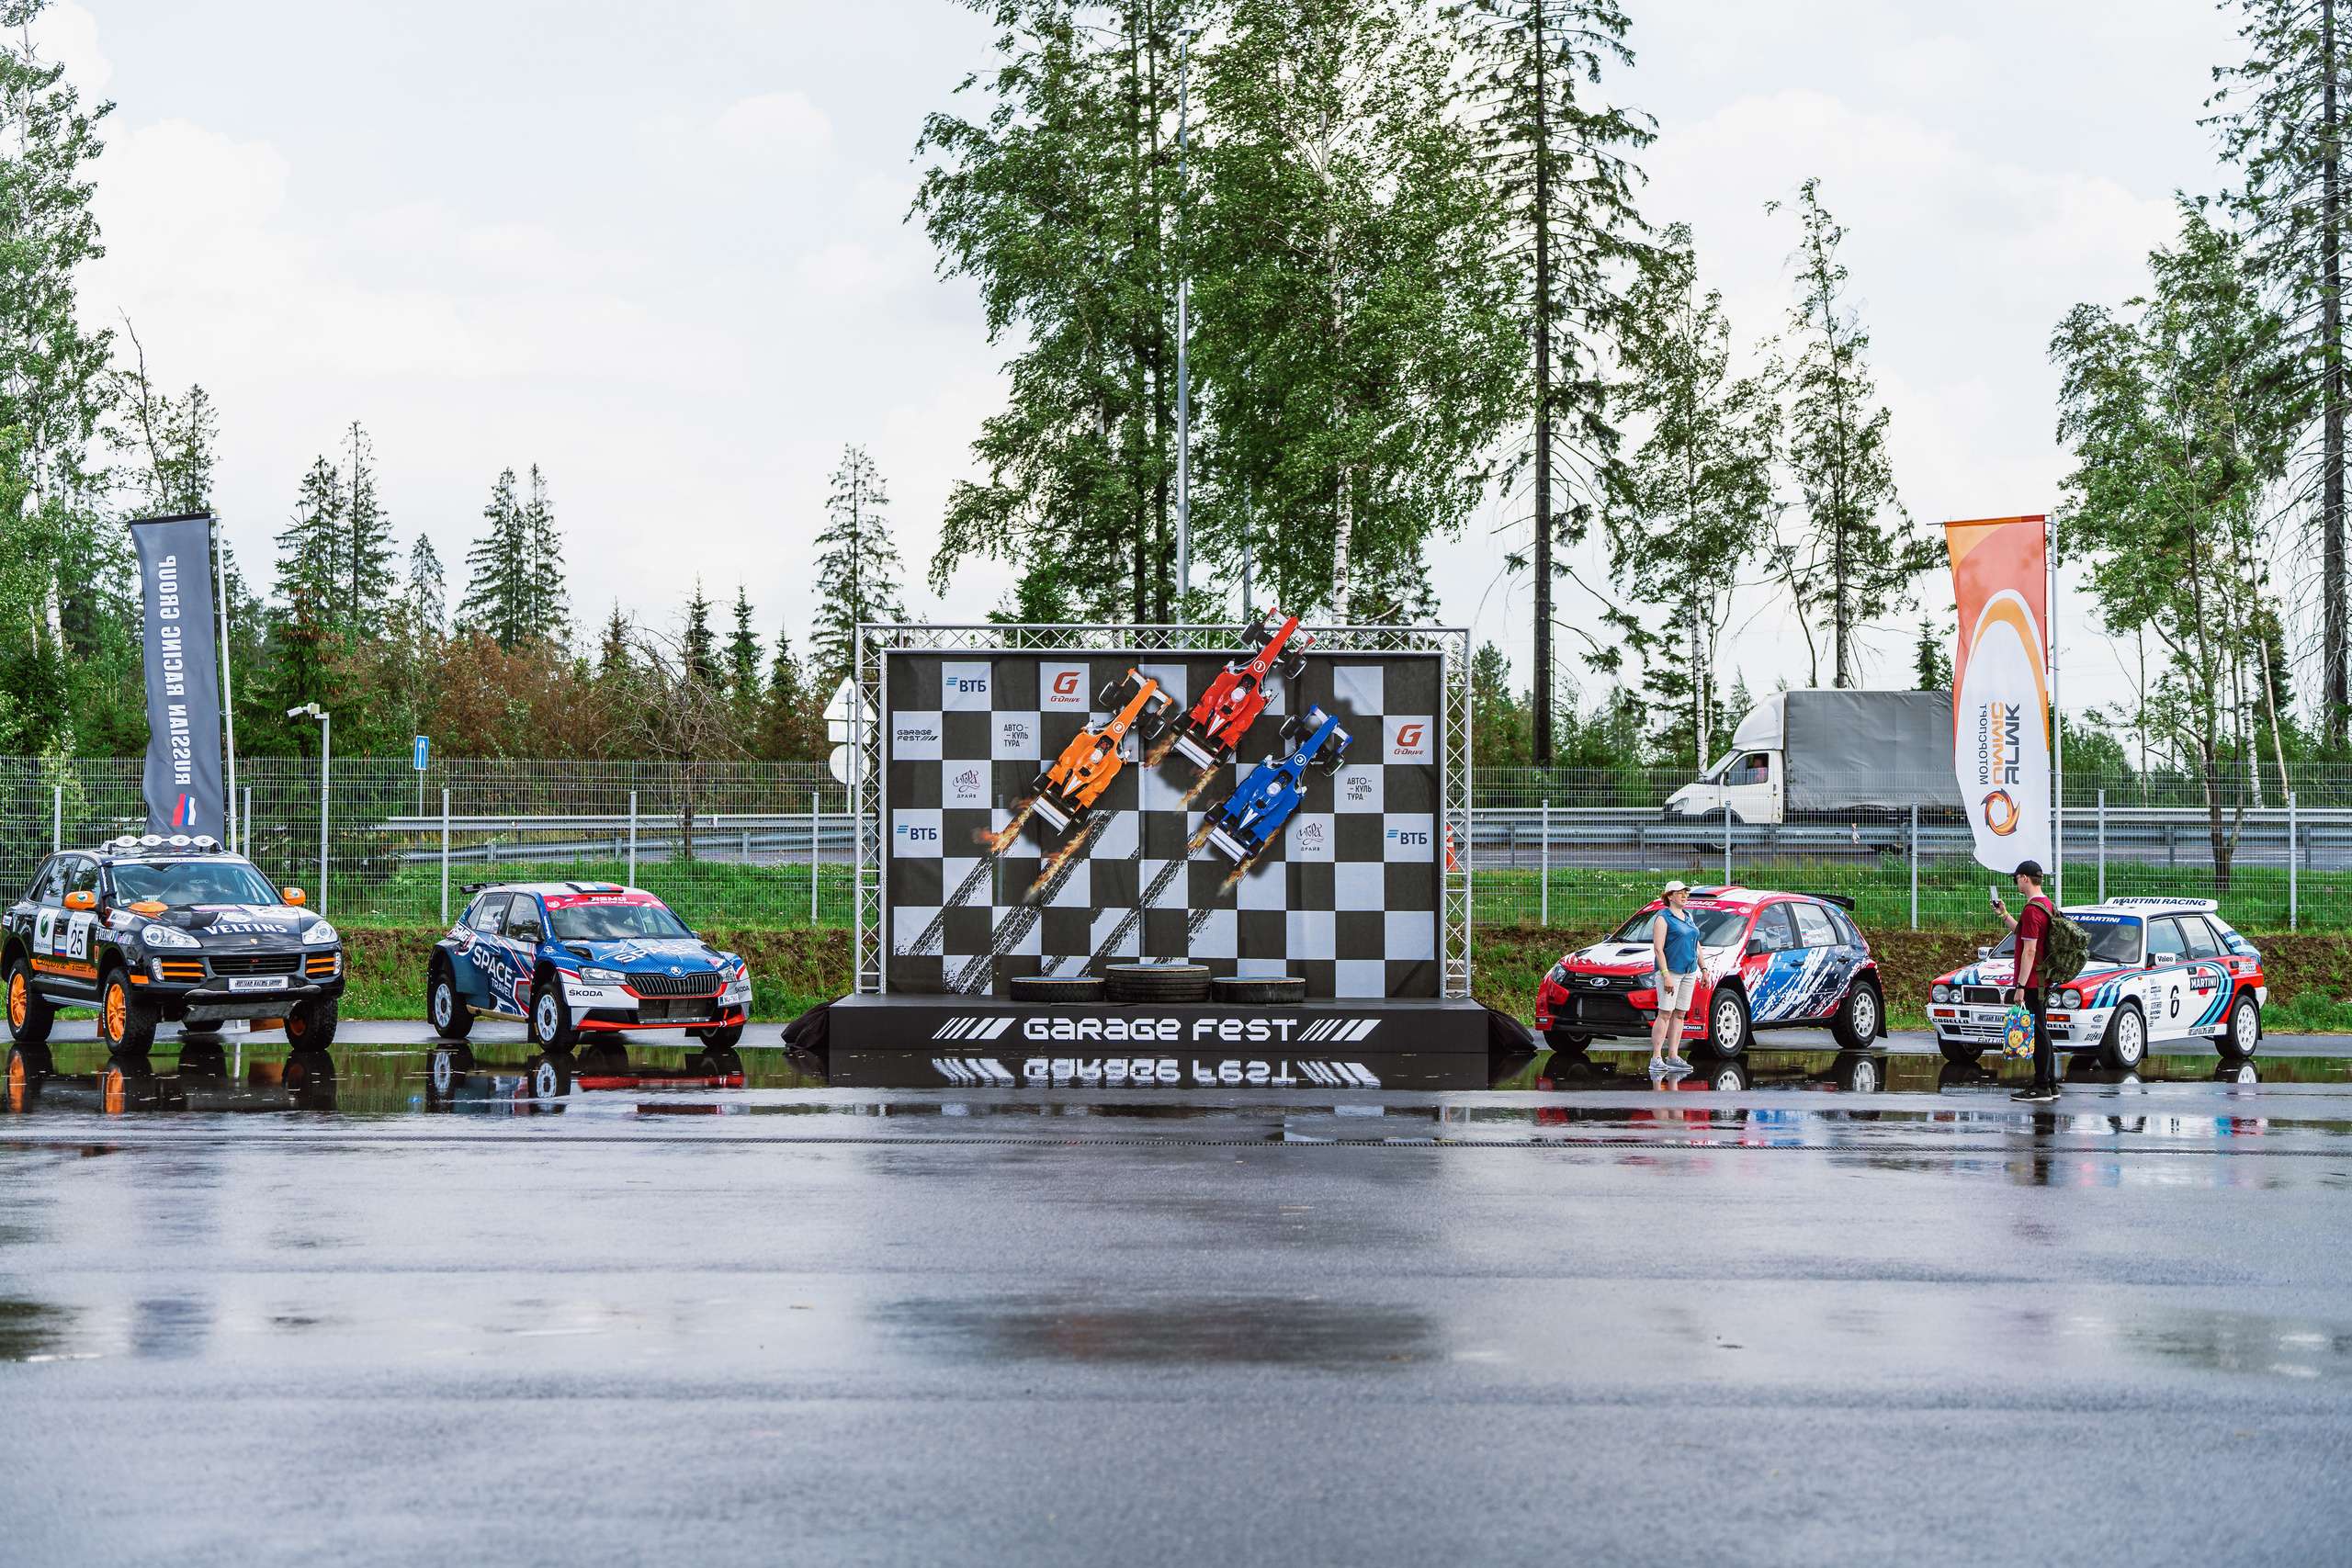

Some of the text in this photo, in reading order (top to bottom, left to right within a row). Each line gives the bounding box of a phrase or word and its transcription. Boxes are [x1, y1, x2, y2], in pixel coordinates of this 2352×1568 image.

[959, 680, 987, 693] ВТБ
[910, 828, 937, 840] ВТБ
[1400, 832, 1428, 845] ВТБ
[203, 923, 288, 935] VELTINS
[70, 930, 83, 955] 25
[472, 945, 513, 988] SPACE
[492, 977, 512, 998] TRAVEL
[2191, 976, 2216, 988] MARTINI
[569, 988, 603, 997] ŠKODA
[2170, 985, 2179, 1019] 6
